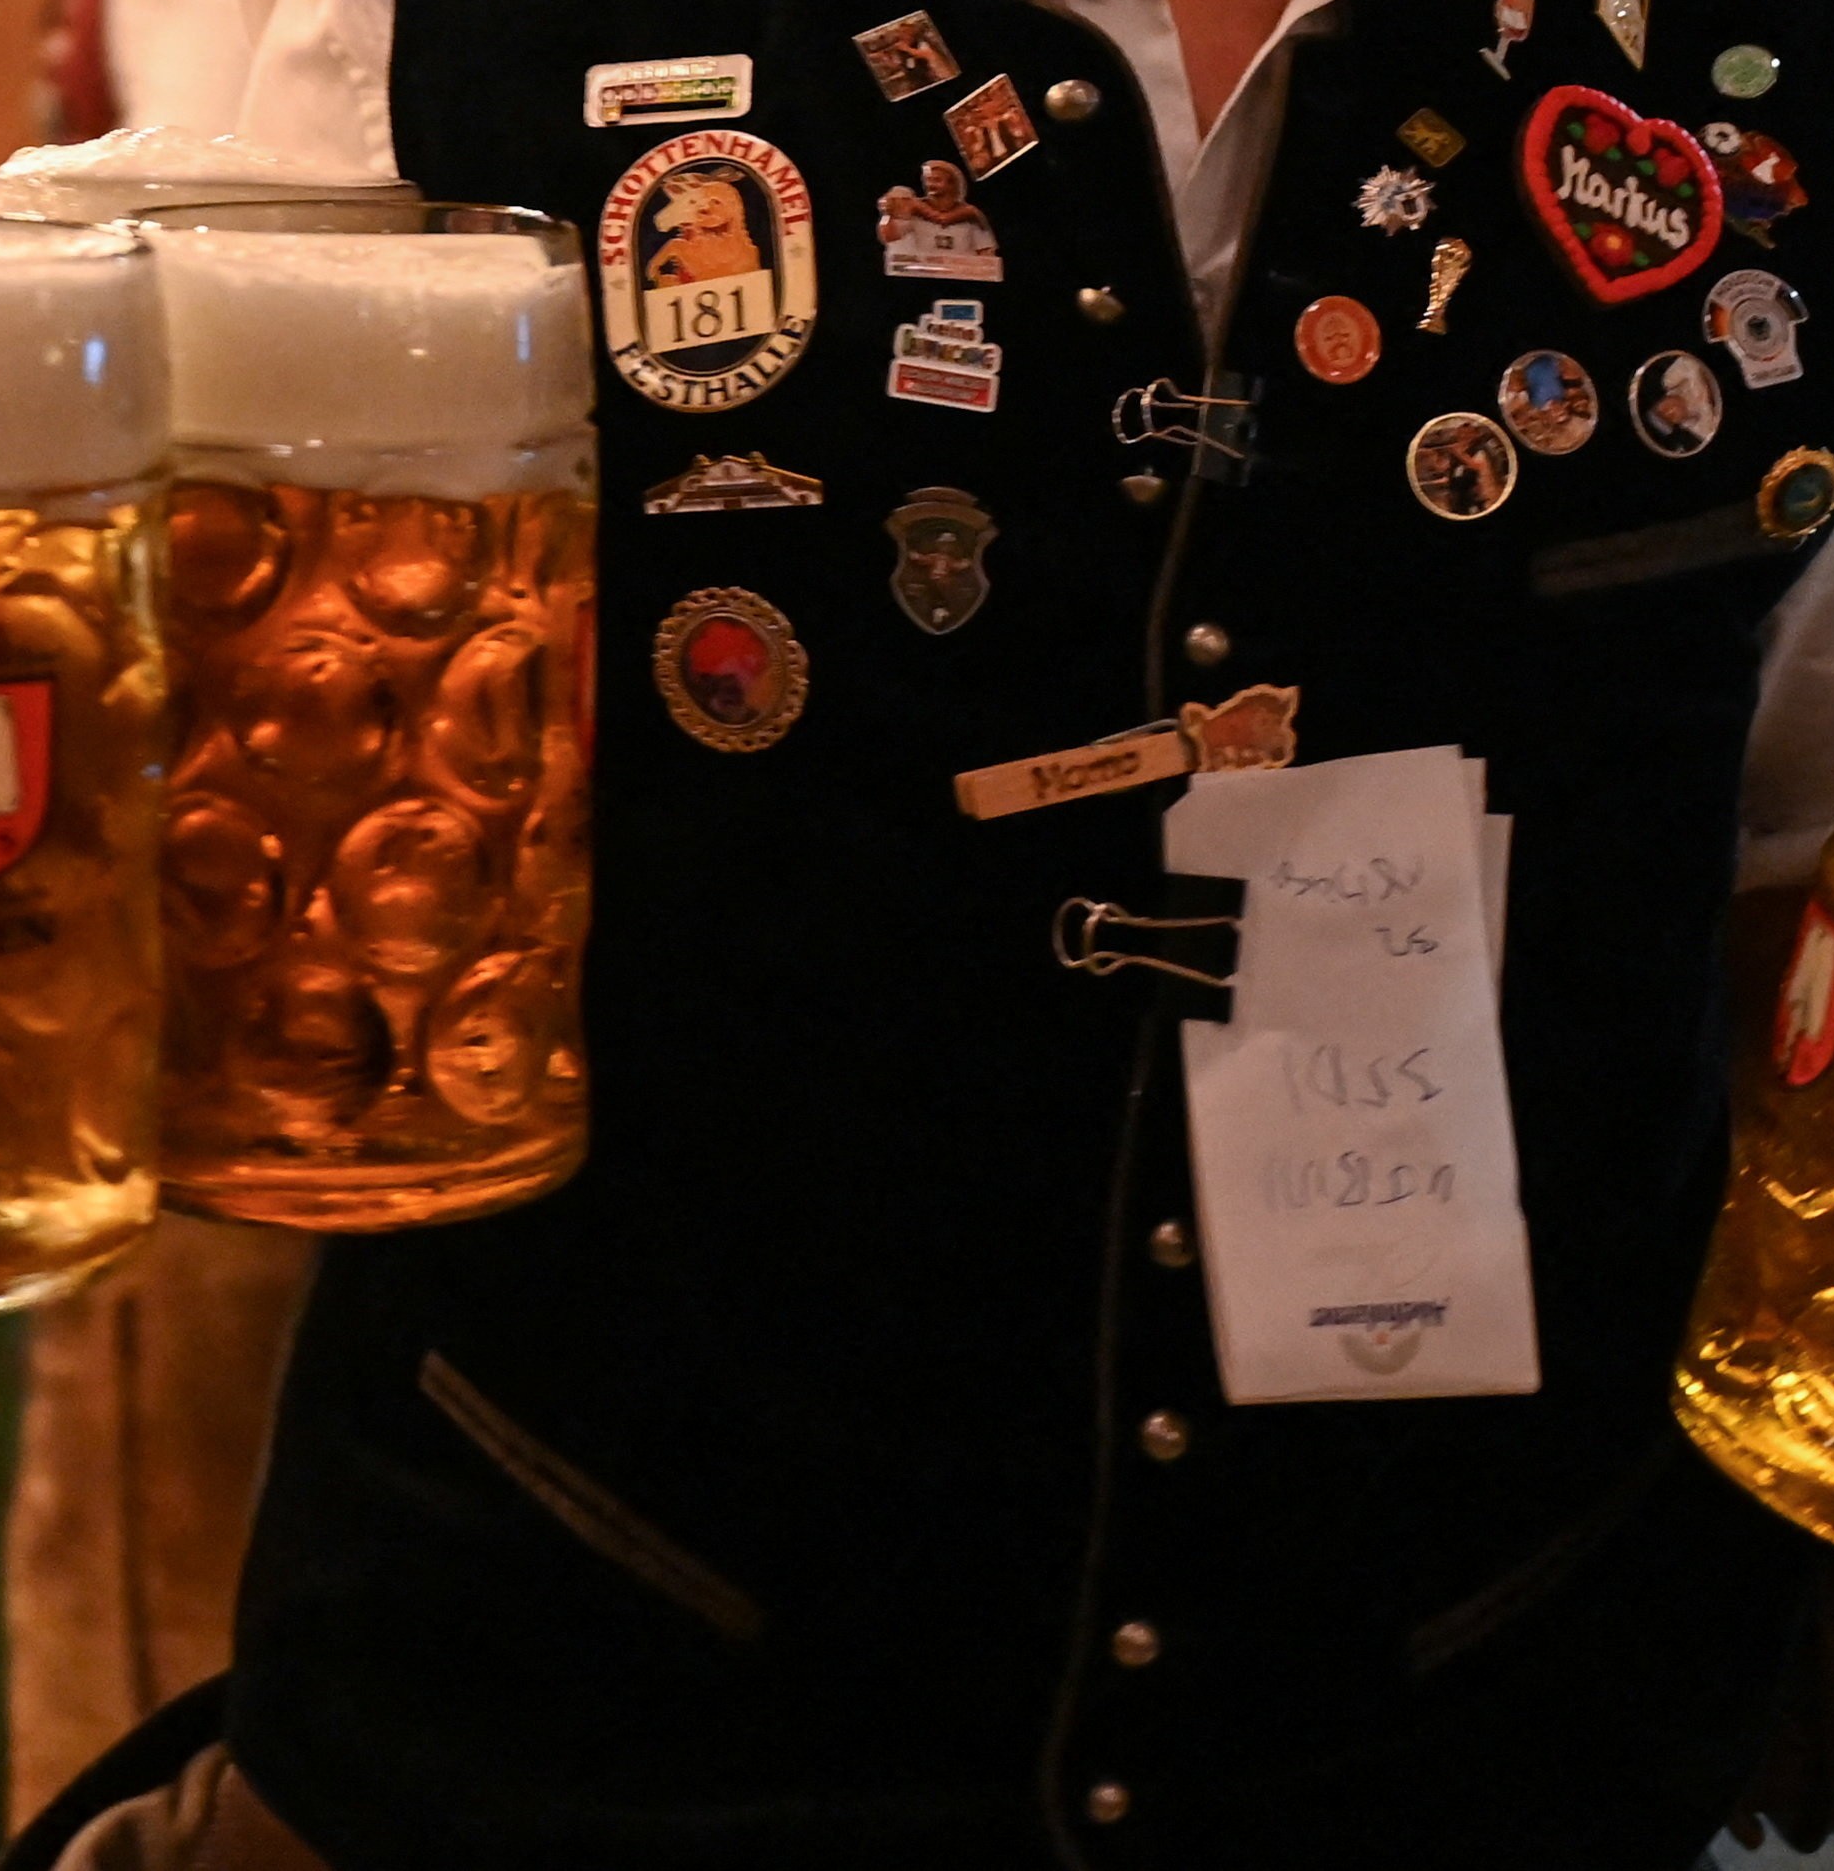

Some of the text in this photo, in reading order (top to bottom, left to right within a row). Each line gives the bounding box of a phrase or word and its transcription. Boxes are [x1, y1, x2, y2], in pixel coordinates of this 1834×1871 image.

[601, 133, 810, 266] SCHOTTENHAMEL
[615, 314, 814, 406] FESTHALLE
[666, 285, 746, 343] 181
